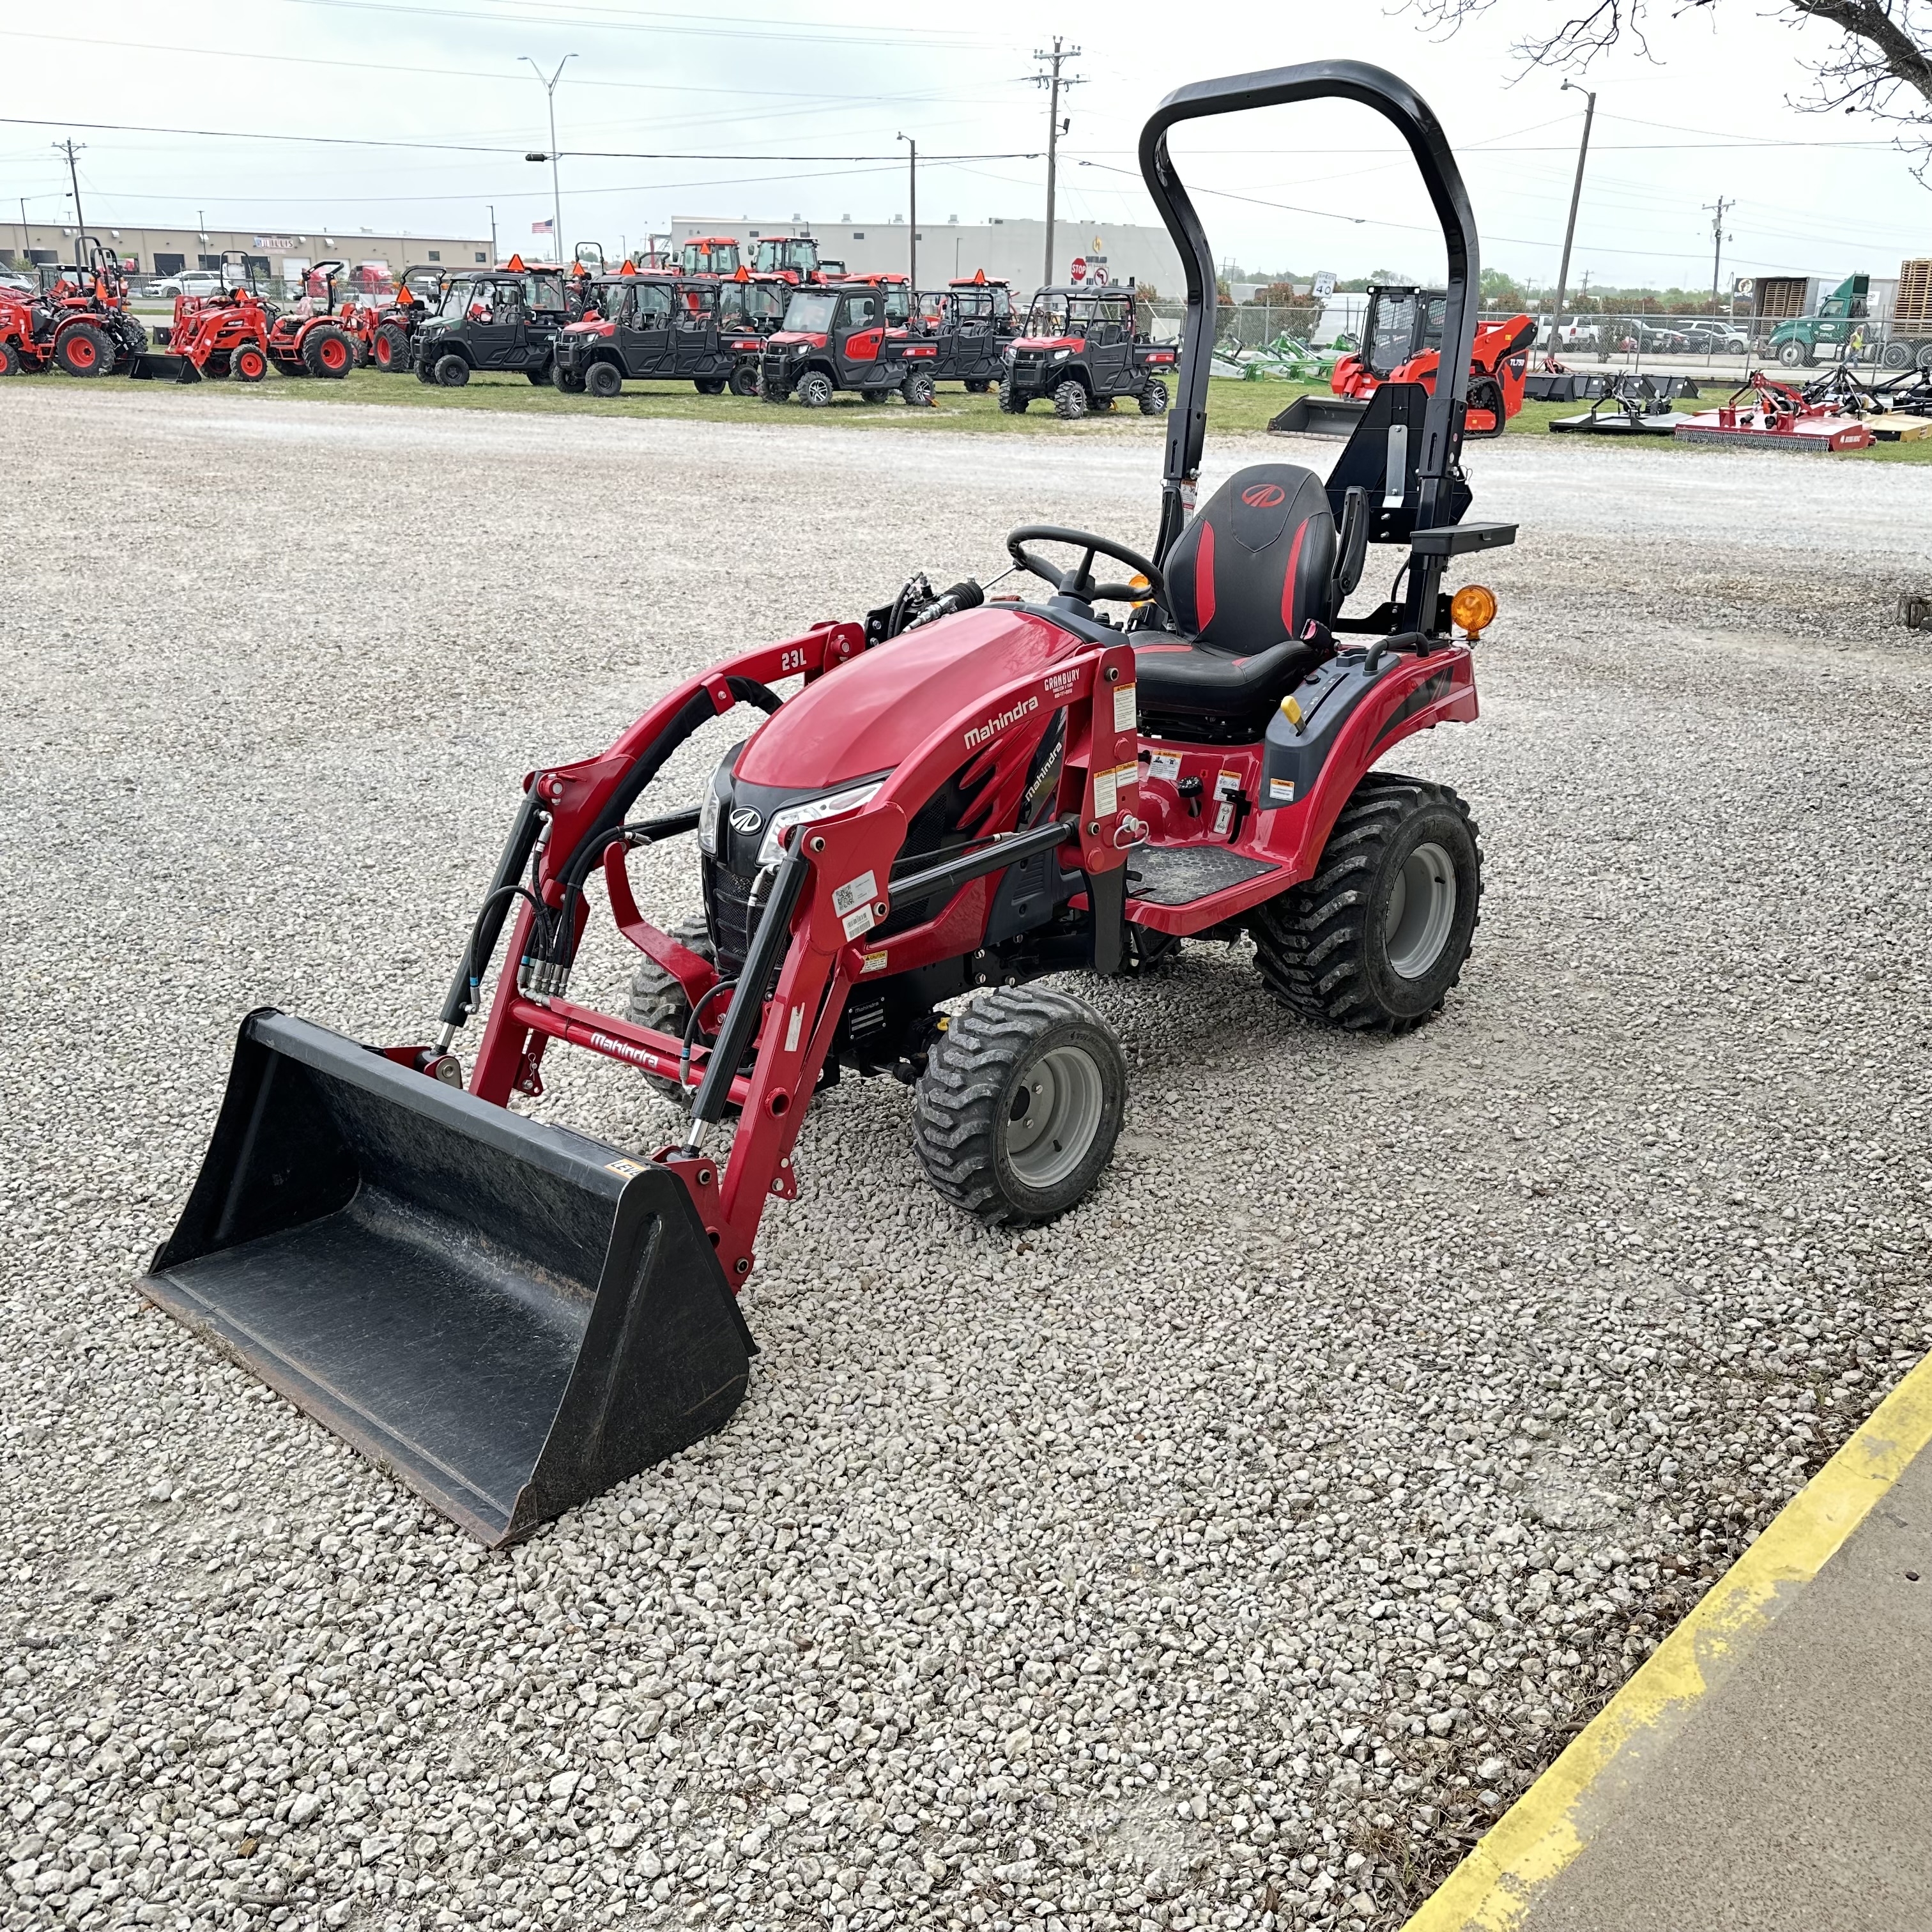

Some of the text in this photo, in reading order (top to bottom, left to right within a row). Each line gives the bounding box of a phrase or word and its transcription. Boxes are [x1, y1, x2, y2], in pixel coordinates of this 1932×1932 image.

[1071, 264, 1086, 275] STOP
[1316, 286, 1331, 295] 40
[781, 647, 807, 671] 23L
[1044, 668, 1080, 691] GRANBURY
[963, 696, 1039, 750] Mahindra
[1025, 741, 1062, 802] Mahindra
[590, 1032, 659, 1069] Mahindra
